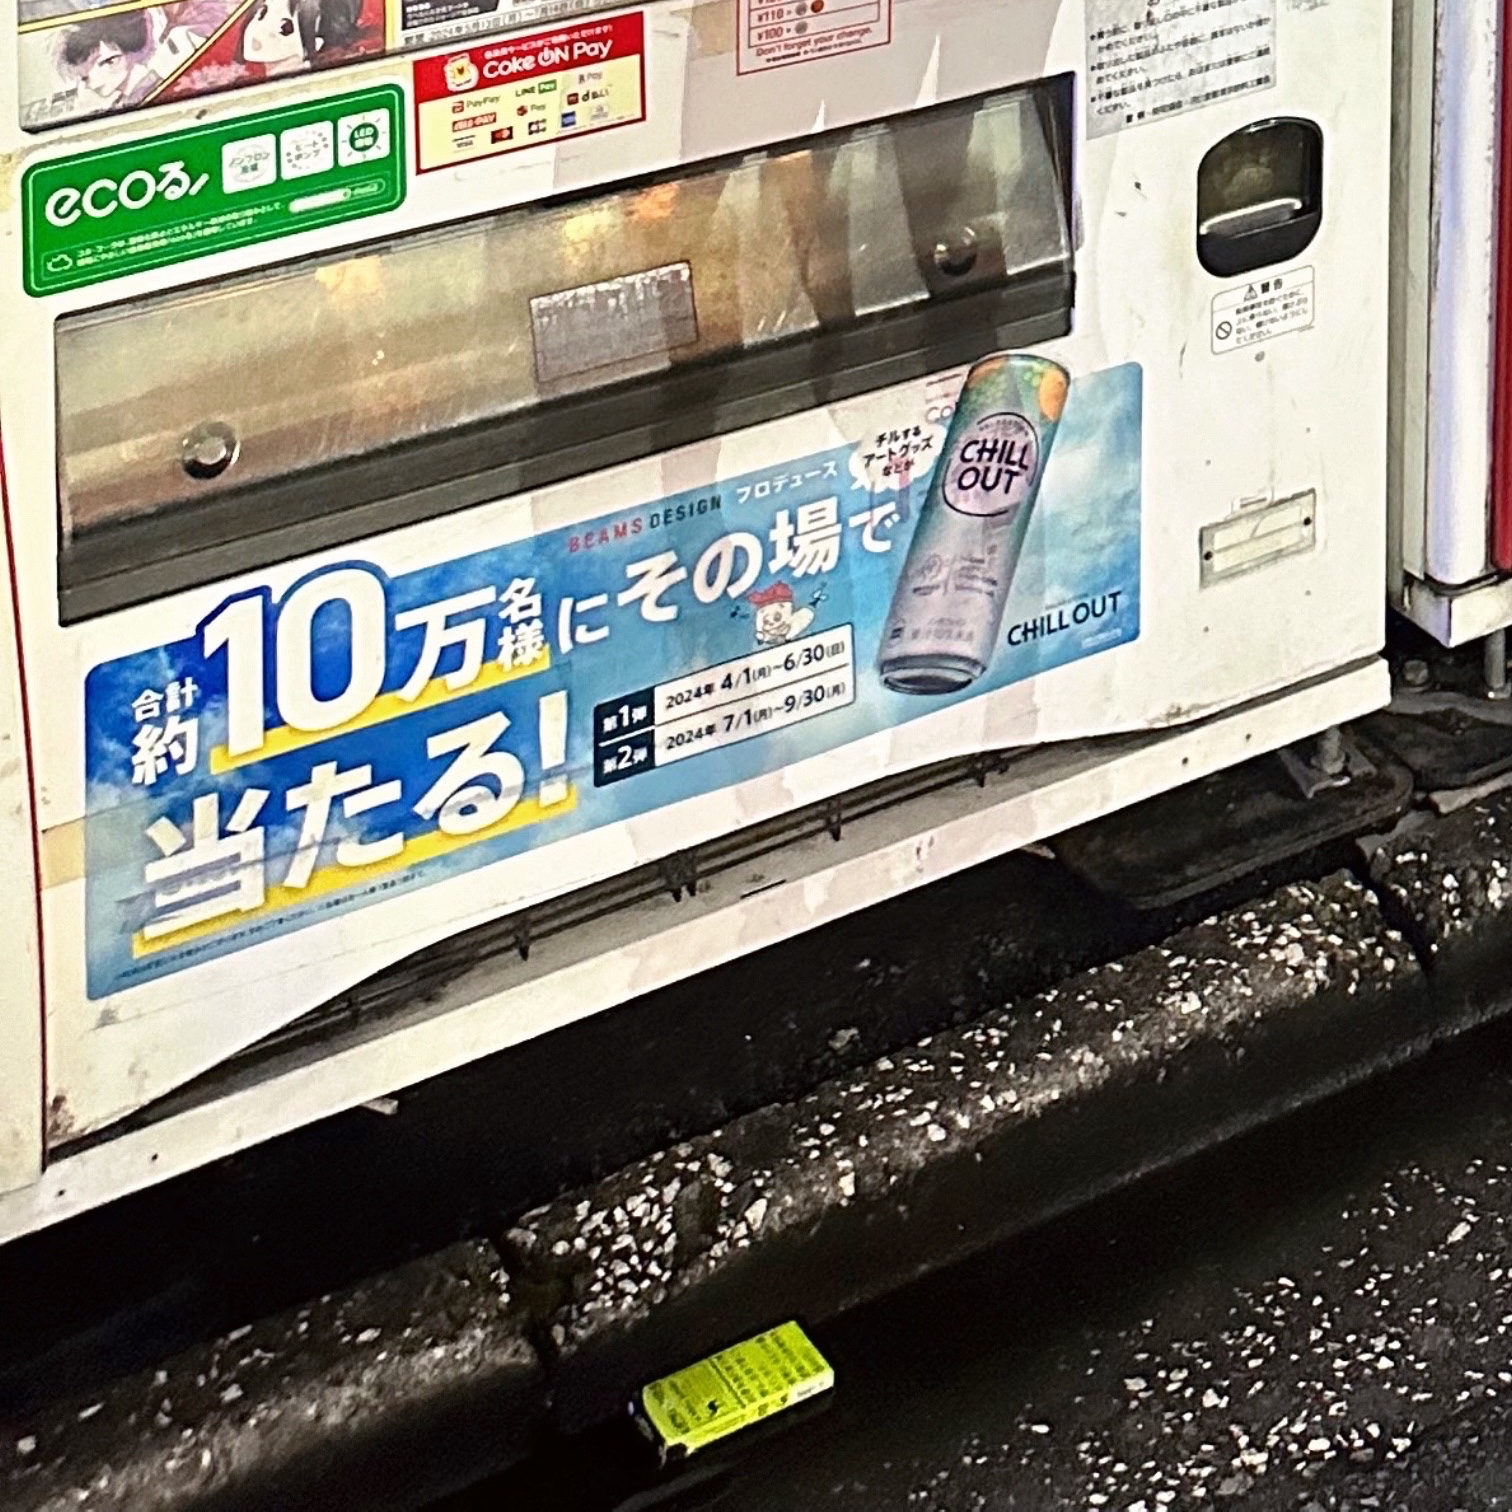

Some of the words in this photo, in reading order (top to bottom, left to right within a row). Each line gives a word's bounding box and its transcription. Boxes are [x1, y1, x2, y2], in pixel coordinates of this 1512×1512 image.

[757, 26, 784, 41] ¥100
[482, 55, 536, 79] Coke
[537, 45, 570, 66] ON
[572, 38, 614, 61] Pay
[353, 126, 375, 140] LED
[862, 434, 934, 467] アートグッズ
[875, 424, 922, 448] チルする
[959, 438, 1030, 471] CHILL
[735, 459, 839, 504] プロデュース
[957, 466, 1023, 495] OUT
[566, 516, 645, 553] BEAMS
[648, 494, 724, 532] DESIGN
[1007, 609, 1070, 646] CHILL
[1072, 590, 1122, 624] OUT
[130, 719, 198, 787] 約
[616, 494, 902, 624] その場で
[130, 677, 200, 720] 合計
[665, 681, 717, 710] 2024年
[602, 702, 648, 734] 第1弾
[666, 723, 717, 751] 2024年
[602, 744, 648, 775] 第2弾
[141, 689, 570, 941] 当たる!
